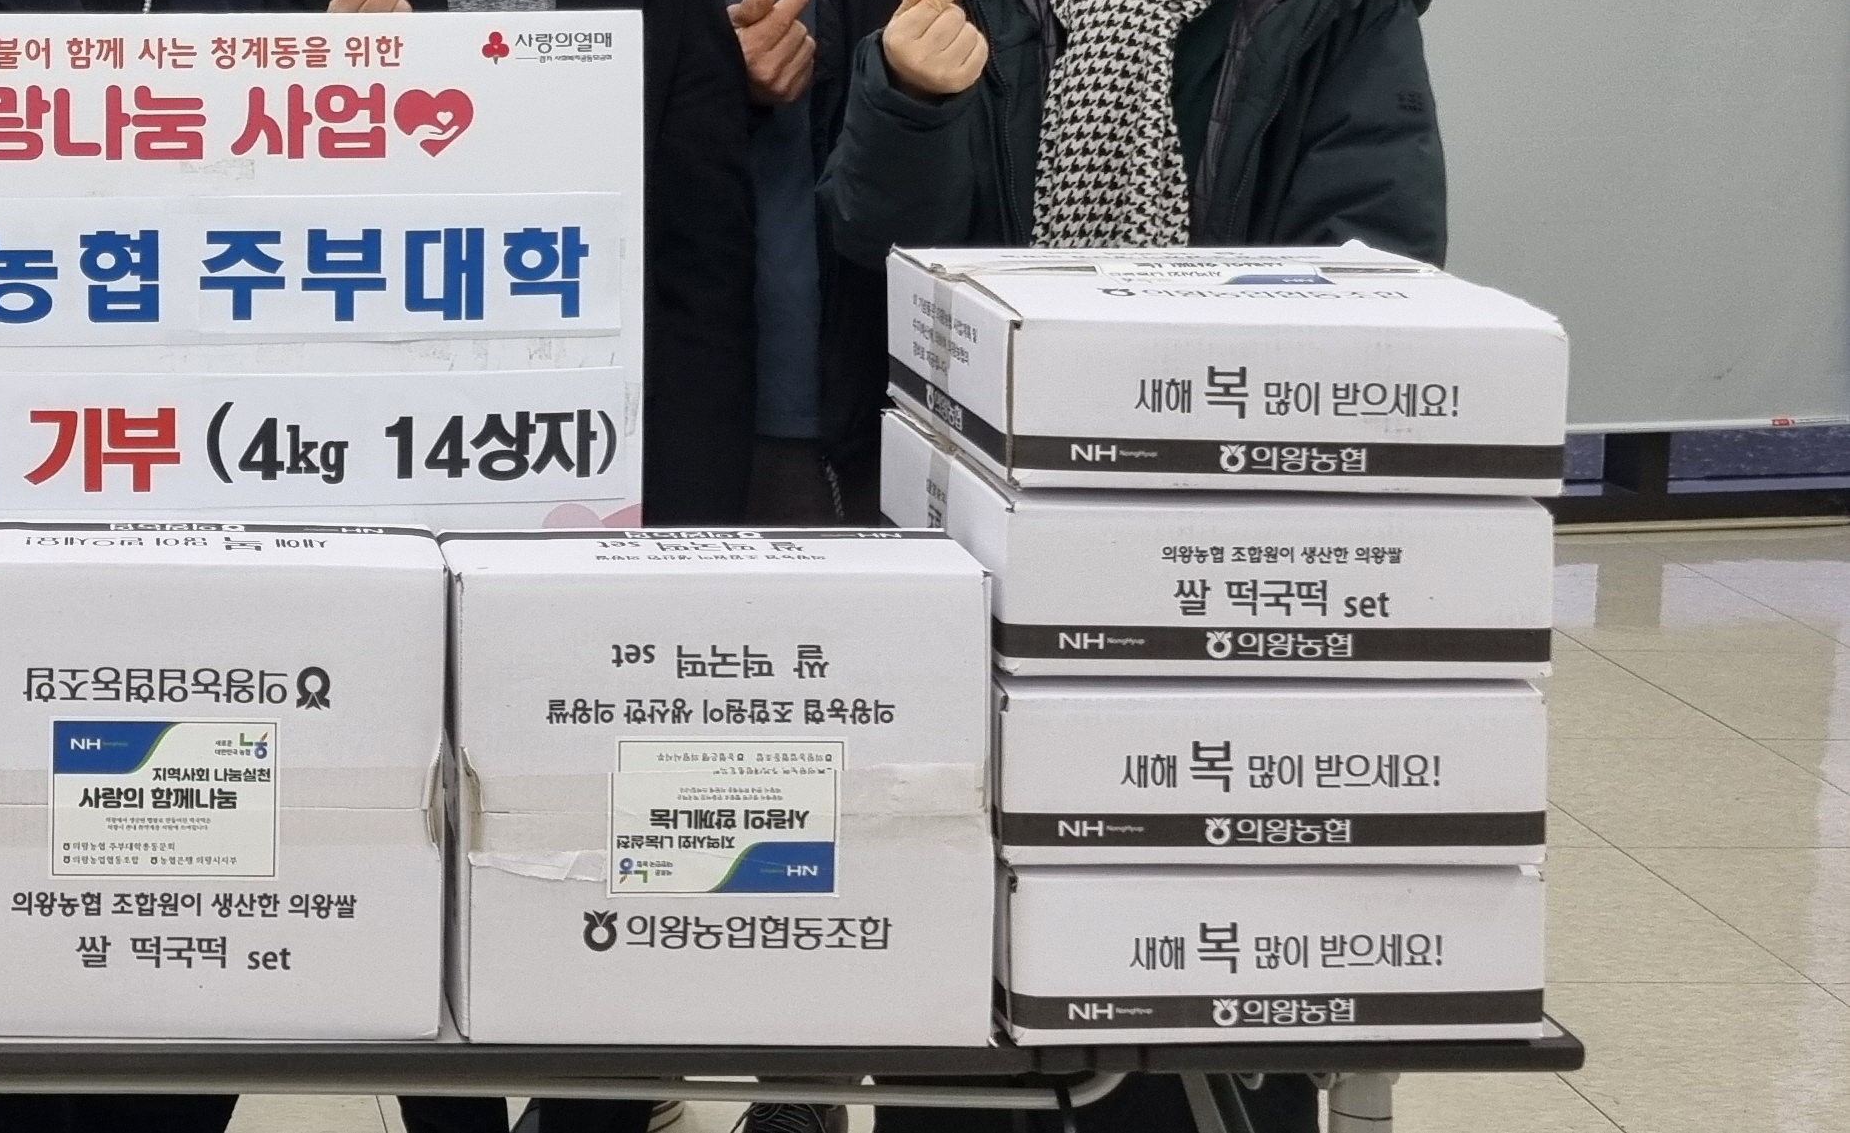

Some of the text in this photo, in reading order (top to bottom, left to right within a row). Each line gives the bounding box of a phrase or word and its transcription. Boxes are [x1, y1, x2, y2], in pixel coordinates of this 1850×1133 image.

[66, 38, 123, 69] 함께
[138, 38, 197, 69] 사는
[211, 37, 331, 69] 청계동을
[345, 36, 403, 67] 위한
[515, 32, 613, 54] 사랑의열매
[231, 83, 386, 159] 사업
[200, 227, 589, 321] 주부대학
[1135, 366, 1458, 419] 새해 복 많이 받으세요!
[24, 408, 180, 492] 기부
[207, 402, 348, 484] (4kg
[385, 409, 616, 481] 14상자)
[1071, 444, 1116, 461] NH
[1252, 447, 1366, 472] 의왕농협
[1162, 546, 1402, 564] 의왕농협 조합원이 생산한 의왕쌀
[1174, 579, 1389, 617] 쌀 떡국떡 set
[1059, 633, 1104, 649] NH
[1238, 633, 1352, 657] 의왕농협
[612, 644, 829, 679] 쌀 떡국떡 set
[23, 667, 287, 704] 의왕농업협동조합
[546, 698, 895, 724] 의왕농협 조합원이 생산한 의왕쌀
[71, 738, 100, 749] NH
[153, 768, 270, 782] 지역사회 나눔실천
[1121, 741, 1440, 792] 새해 복 많이 받으세요!
[79, 787, 237, 809] 사랑의 함께나눔
[650, 809, 809, 829] 사랑의 함께나눔
[1059, 820, 1103, 837] NH
[1237, 819, 1351, 843] 의왕농협
[617, 836, 735, 849] 지역사회 나눔실천
[787, 865, 818, 876] NH
[11, 892, 357, 919] 의왕농협 조합원이 생산한 의왕쌀
[627, 916, 892, 950] 의왕농업협동조합
[76, 936, 291, 970] 쌀 떡국떡 set
[1130, 922, 1442, 974] 새해 복 많이 받으세요!
[1069, 1003, 1113, 1020] NH
[1244, 998, 1354, 1024] 의왕농협
